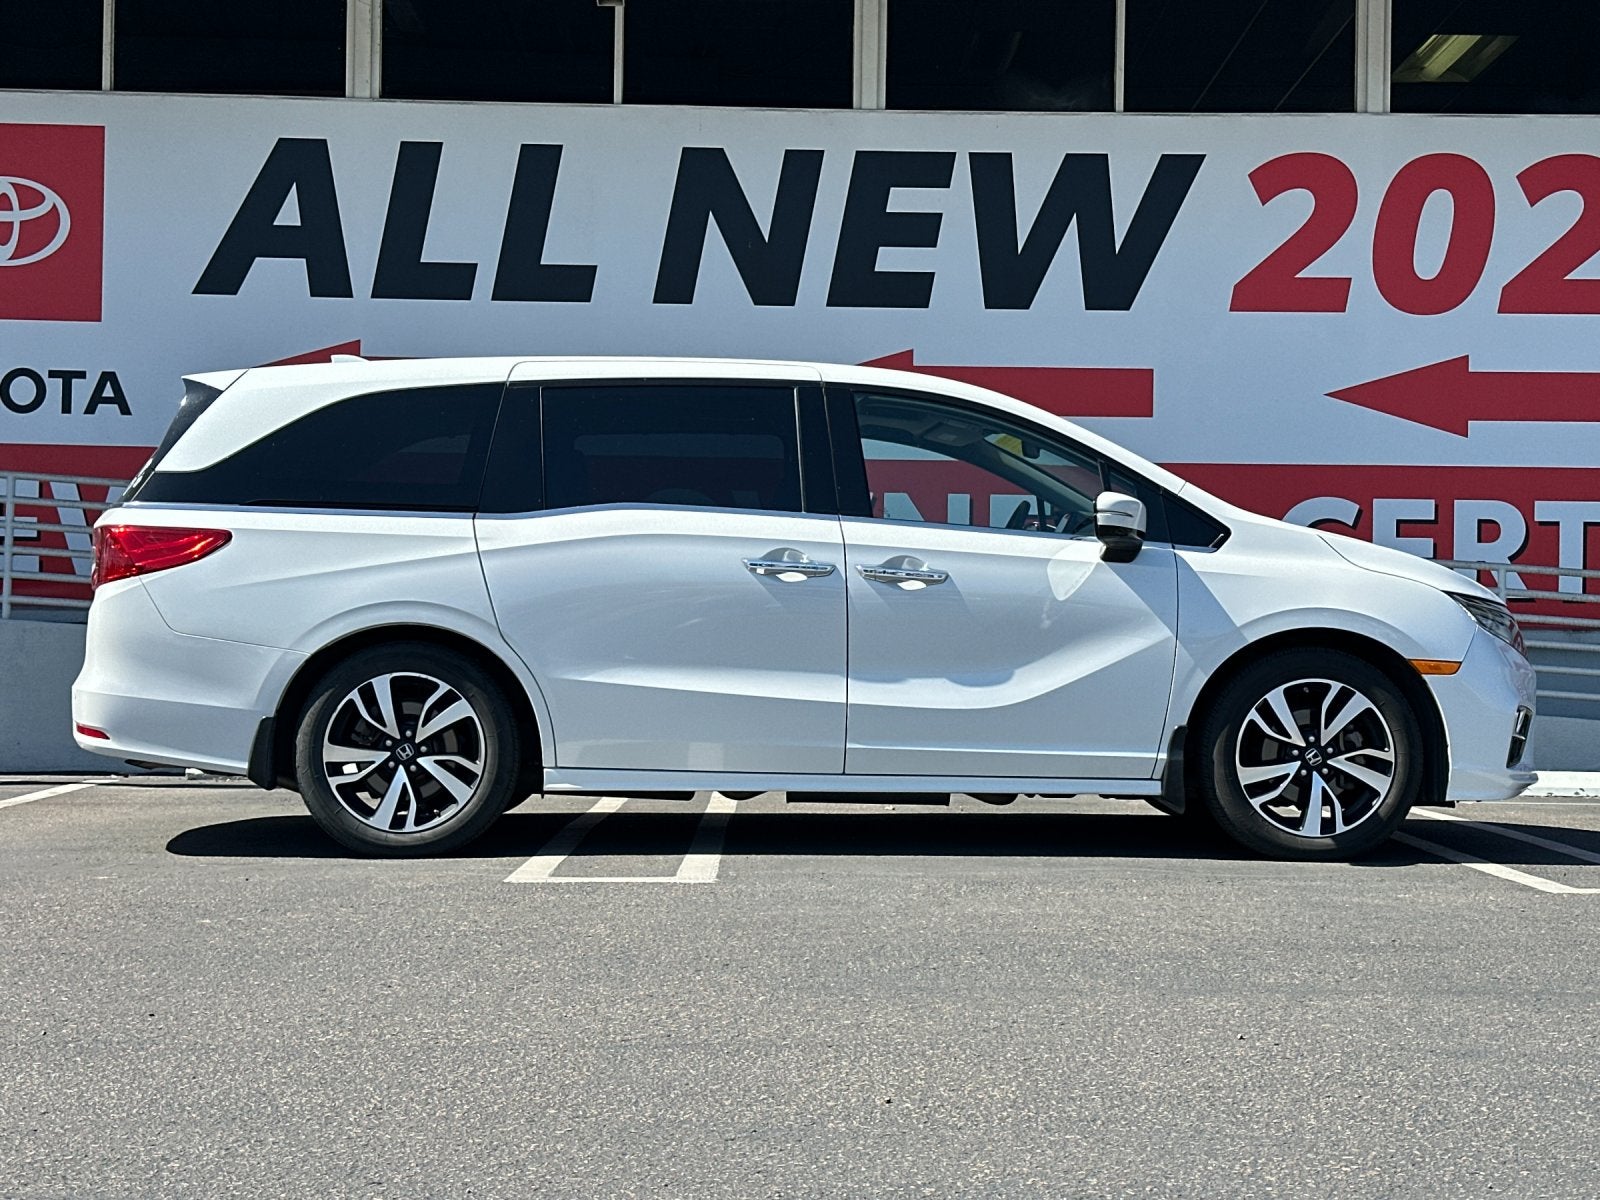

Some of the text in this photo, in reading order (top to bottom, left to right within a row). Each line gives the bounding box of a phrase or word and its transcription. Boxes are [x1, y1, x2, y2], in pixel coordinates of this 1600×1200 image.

[192, 138, 597, 302] ALL
[653, 147, 1206, 310] NEW
[1282, 496, 1600, 598] ERT
